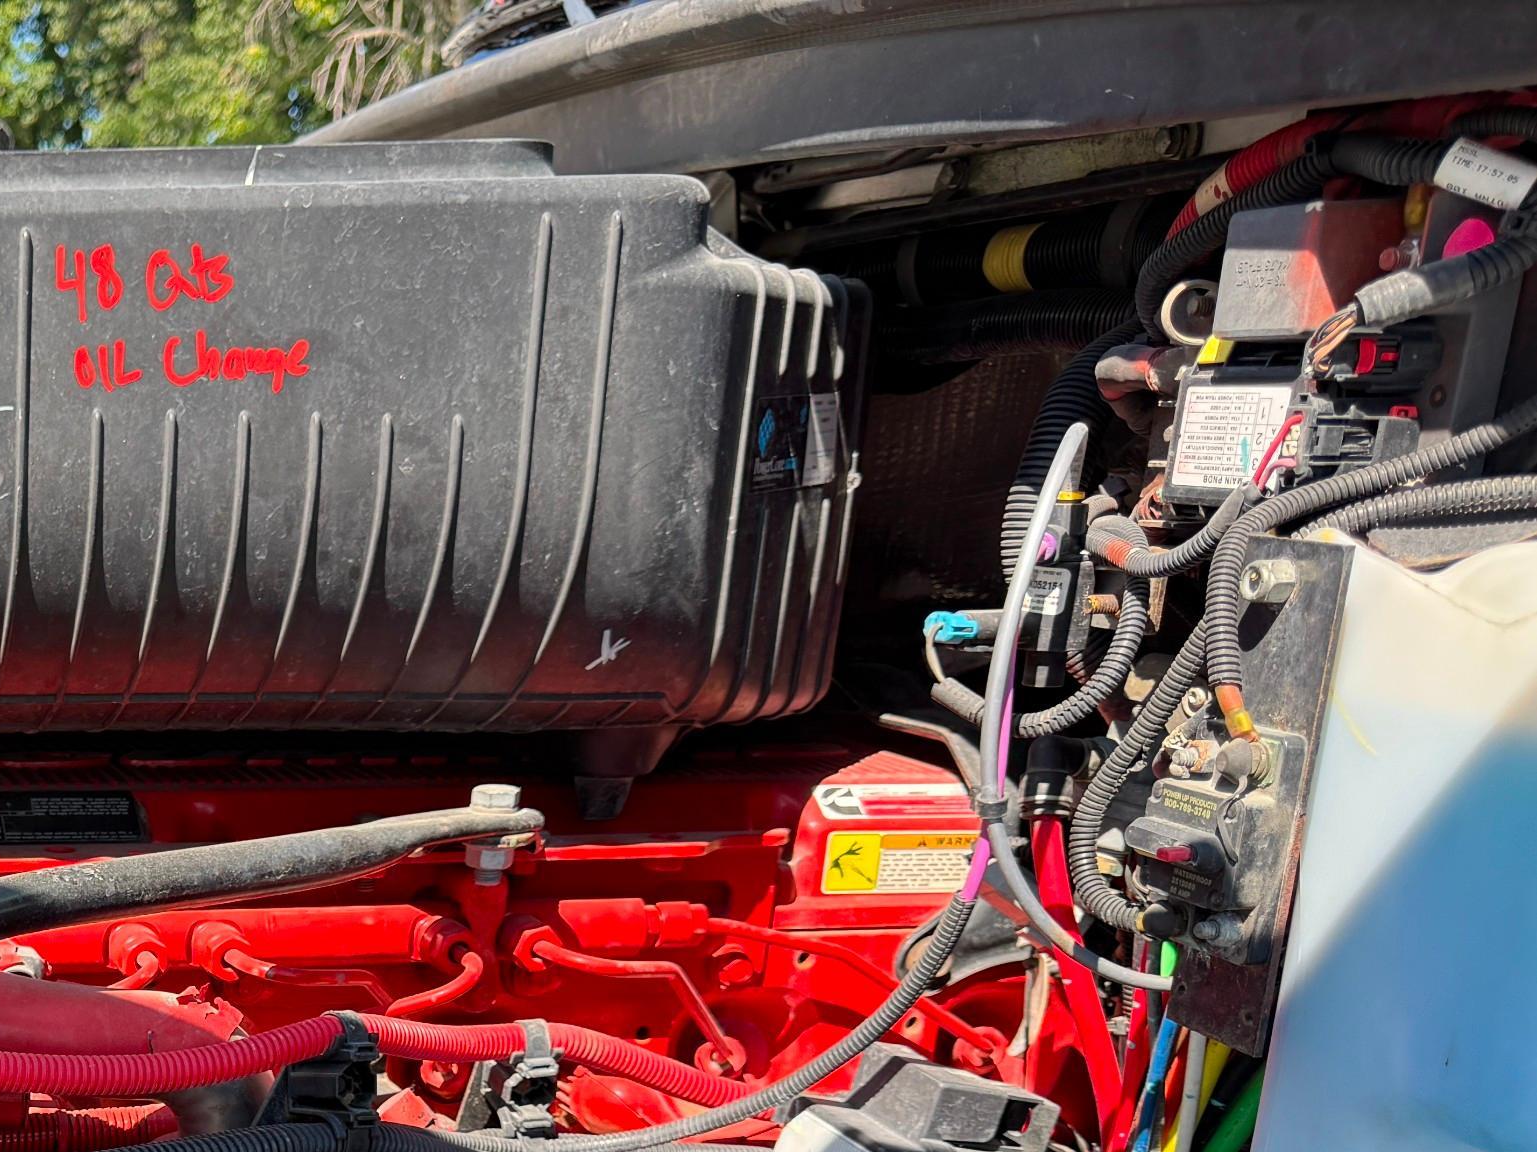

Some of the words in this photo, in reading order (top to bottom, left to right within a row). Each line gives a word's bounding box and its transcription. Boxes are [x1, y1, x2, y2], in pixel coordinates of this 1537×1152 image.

[56, 243, 124, 323] 48
[74, 339, 143, 393] OIL
[163, 330, 310, 394] Change
[1255, 432, 1262, 446] 2
[1203, 475, 1223, 484] PNDB
